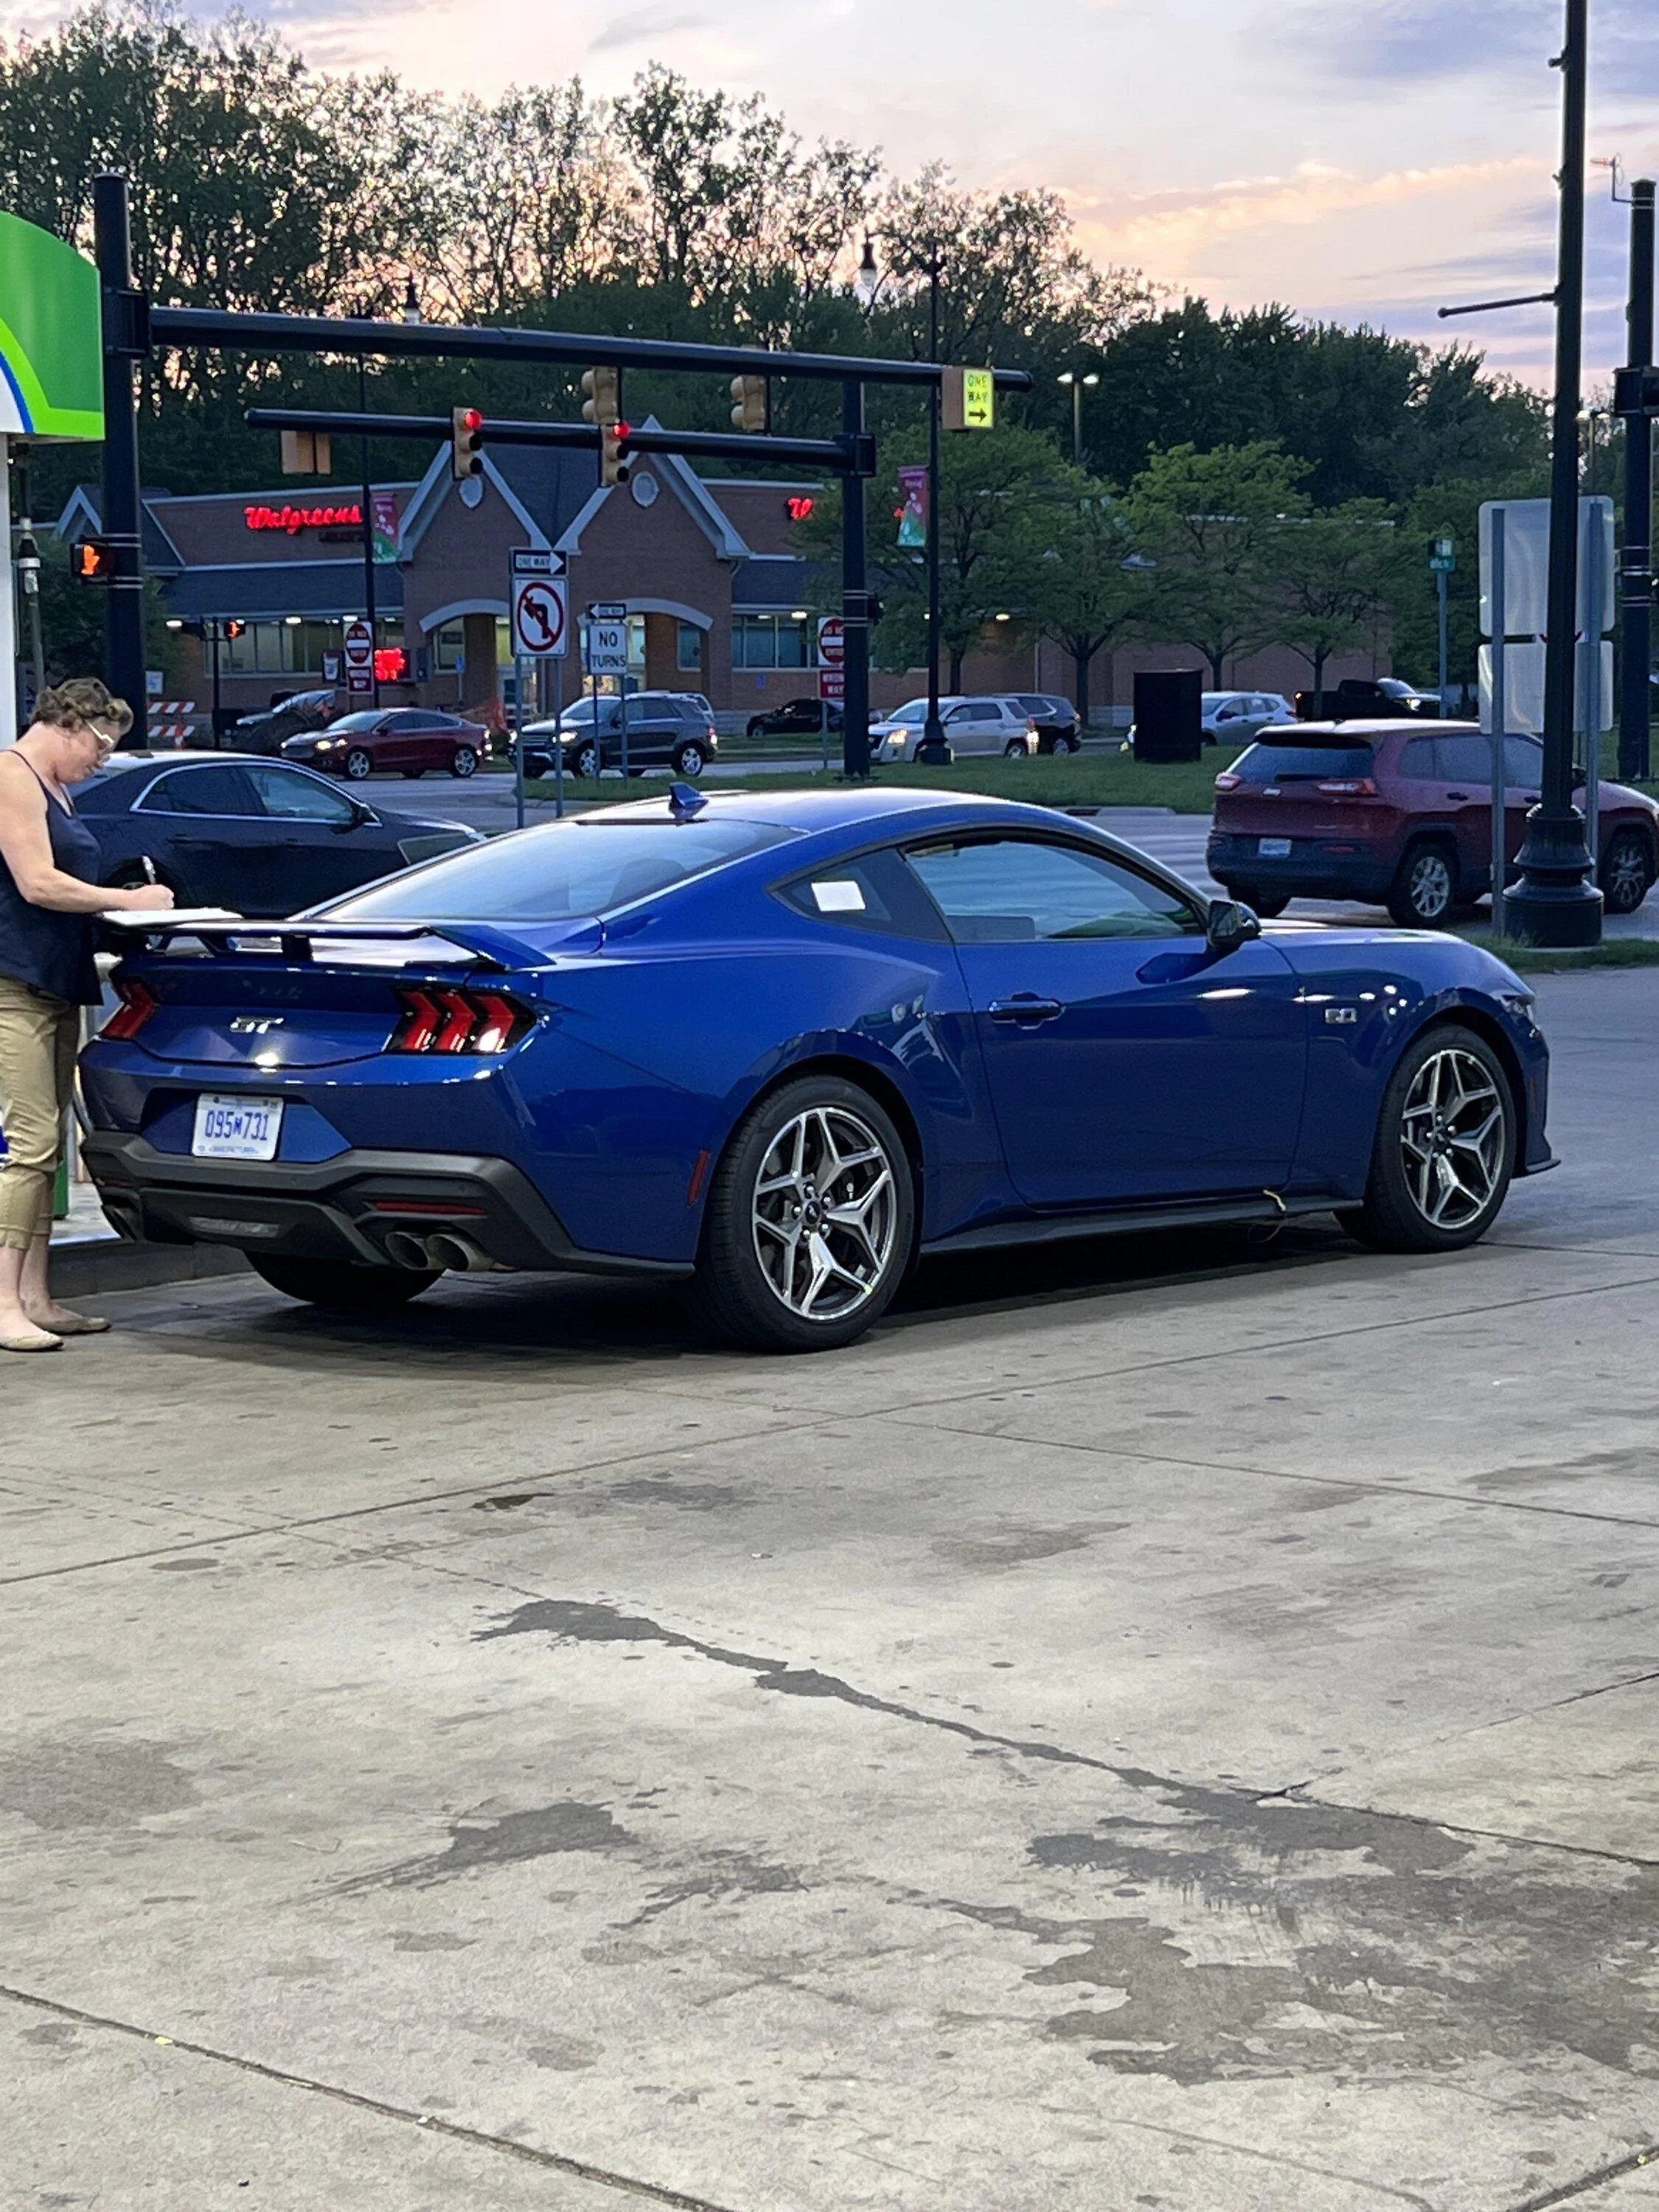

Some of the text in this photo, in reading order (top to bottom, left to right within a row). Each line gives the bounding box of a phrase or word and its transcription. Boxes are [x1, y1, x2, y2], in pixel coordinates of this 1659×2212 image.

[967, 373, 987, 388] ONE
[967, 391, 989, 403] WAY
[244, 504, 362, 535] Walgreens
[598, 630, 618, 647] NO
[591, 654, 627, 668] TURNS
[229, 1016, 285, 1034] GT
